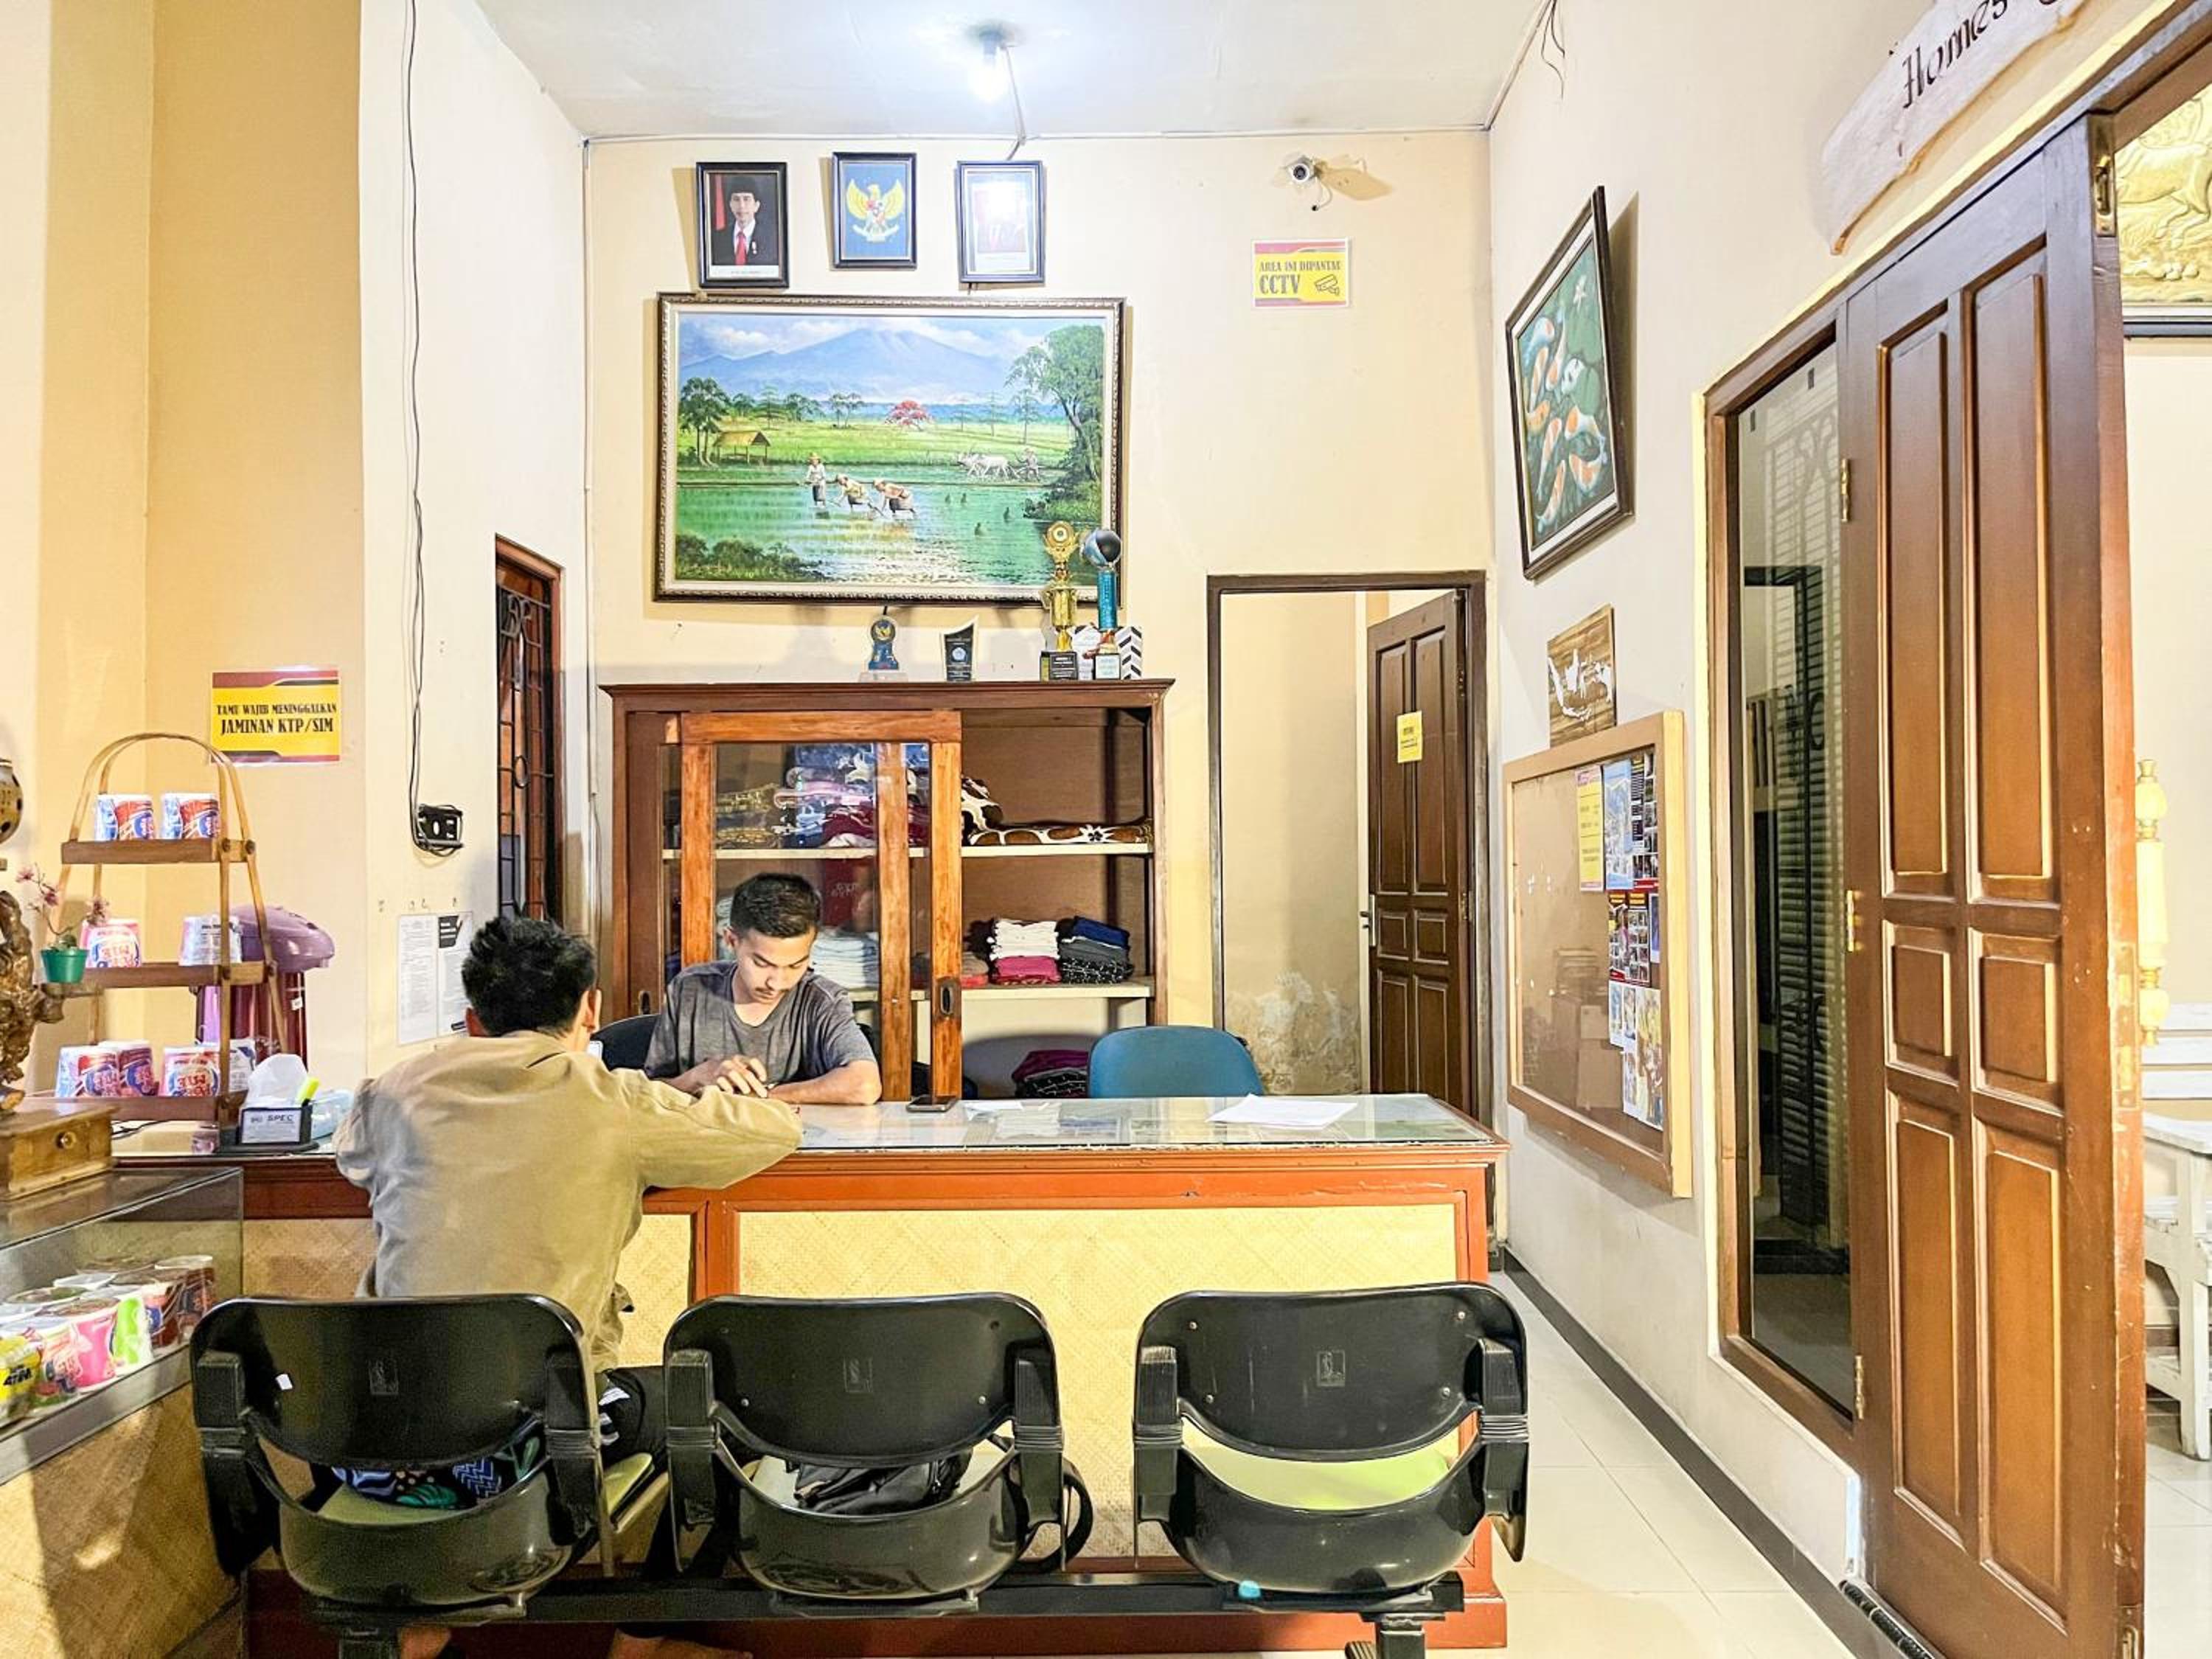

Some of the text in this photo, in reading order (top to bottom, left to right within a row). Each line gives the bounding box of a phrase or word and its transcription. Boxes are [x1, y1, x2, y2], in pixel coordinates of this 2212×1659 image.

[1260, 261, 1281, 271] AREA
[1259, 274, 1300, 294] CCTV
[217, 703, 337, 715] TAMU WAJIB MENINGGALKAN
[221, 718, 333, 735] JAMINAN KTP/SIM
